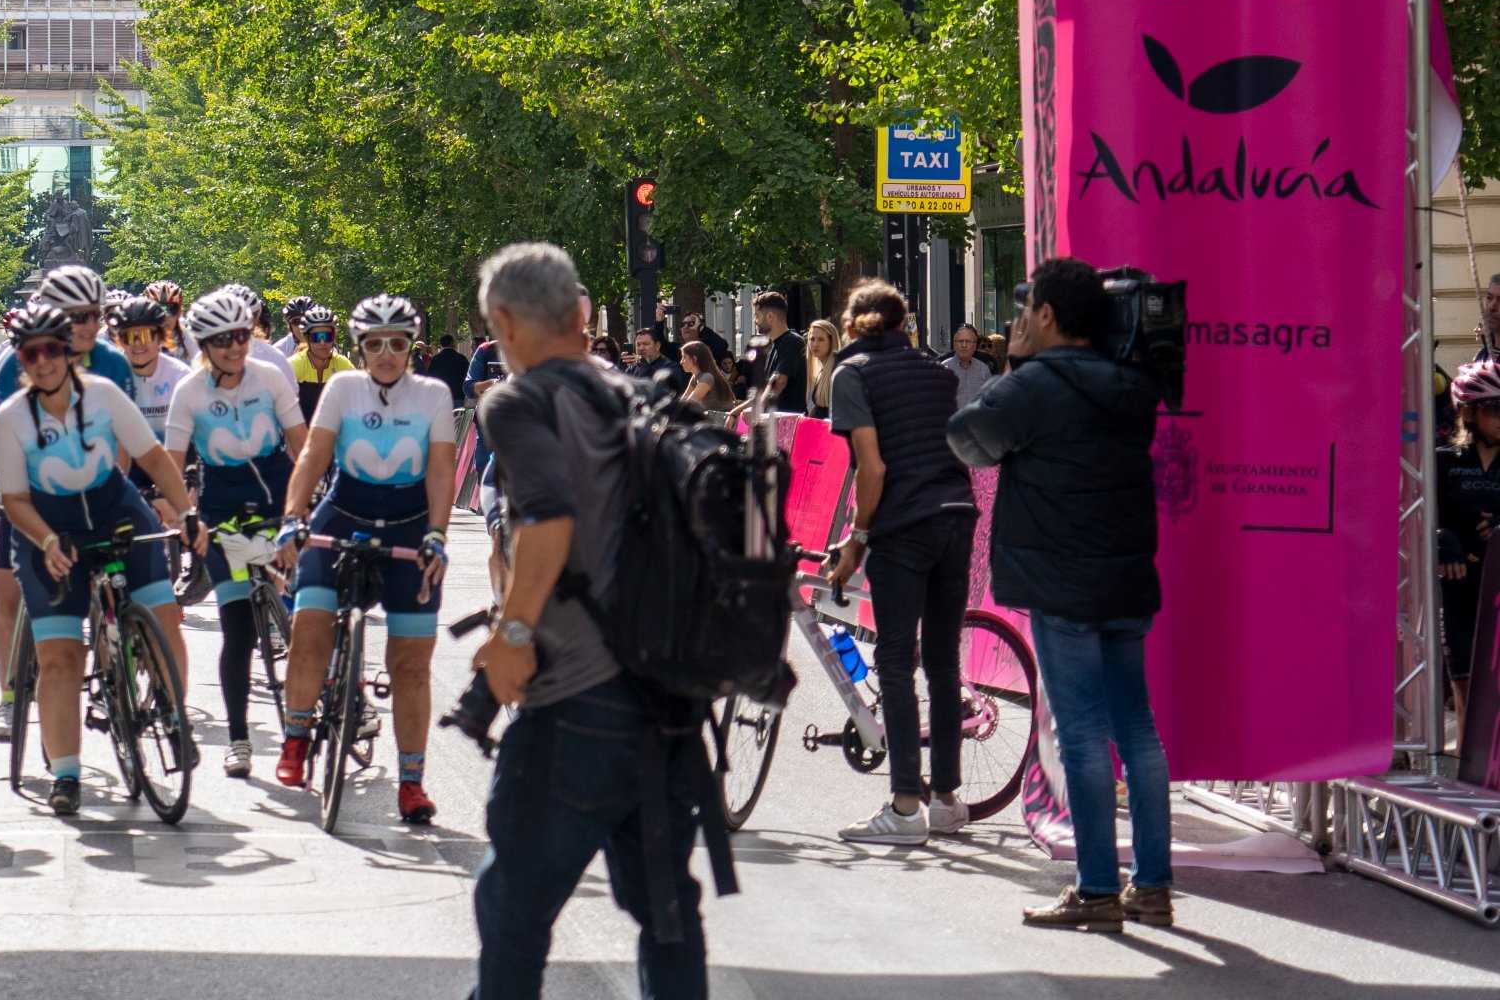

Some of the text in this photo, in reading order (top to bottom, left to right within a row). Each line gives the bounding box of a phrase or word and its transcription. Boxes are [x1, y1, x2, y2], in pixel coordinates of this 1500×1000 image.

[900, 151, 948, 168] TAXI
[1077, 130, 1382, 209] Andalucía
[882, 200, 894, 209] DE
[919, 201, 925, 210] A
[1186, 321, 1331, 354] masagra
